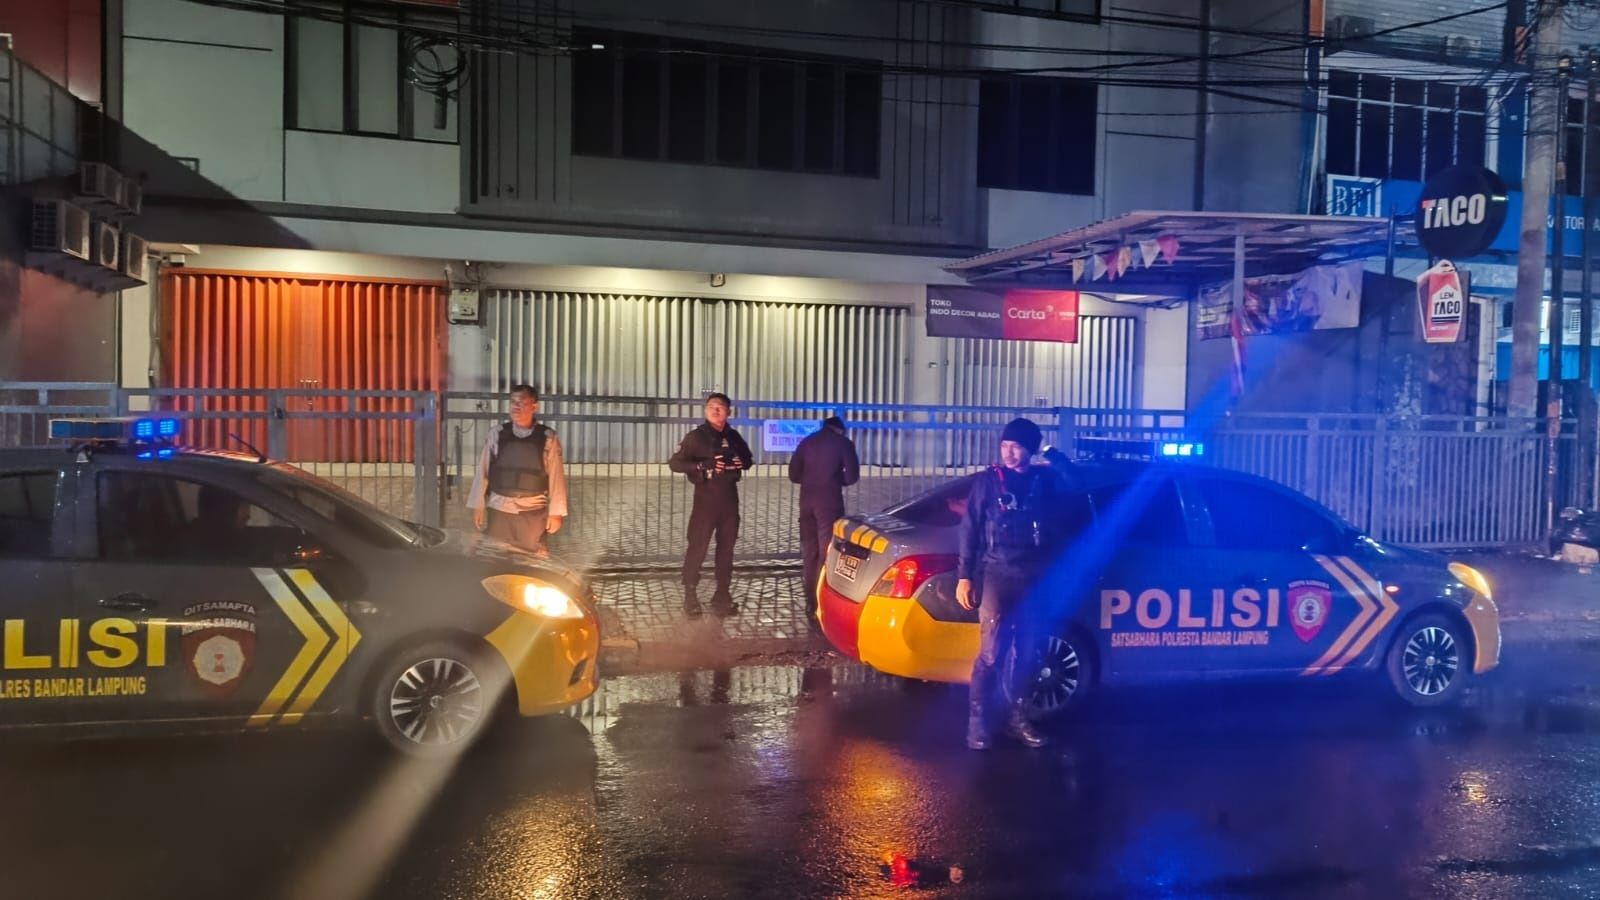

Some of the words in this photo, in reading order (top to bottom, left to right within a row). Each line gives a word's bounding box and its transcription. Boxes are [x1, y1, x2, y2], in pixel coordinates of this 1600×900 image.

[1422, 193, 1487, 229] TACO
[930, 299, 952, 307] TOKO
[1439, 292, 1454, 300] LEM
[930, 308, 950, 316] INDO
[1008, 307, 1046, 320] Carta
[1434, 300, 1461, 315] TACO
[1100, 588, 1280, 630] POLISI
[1162, 631, 1200, 646] POLRESTA
[1201, 631, 1232, 646] BANDAR
[1233, 630, 1269, 645] LAMPUNG
[34, 678, 84, 698] BANDAR
[87, 676, 147, 696] LAMPUNG
